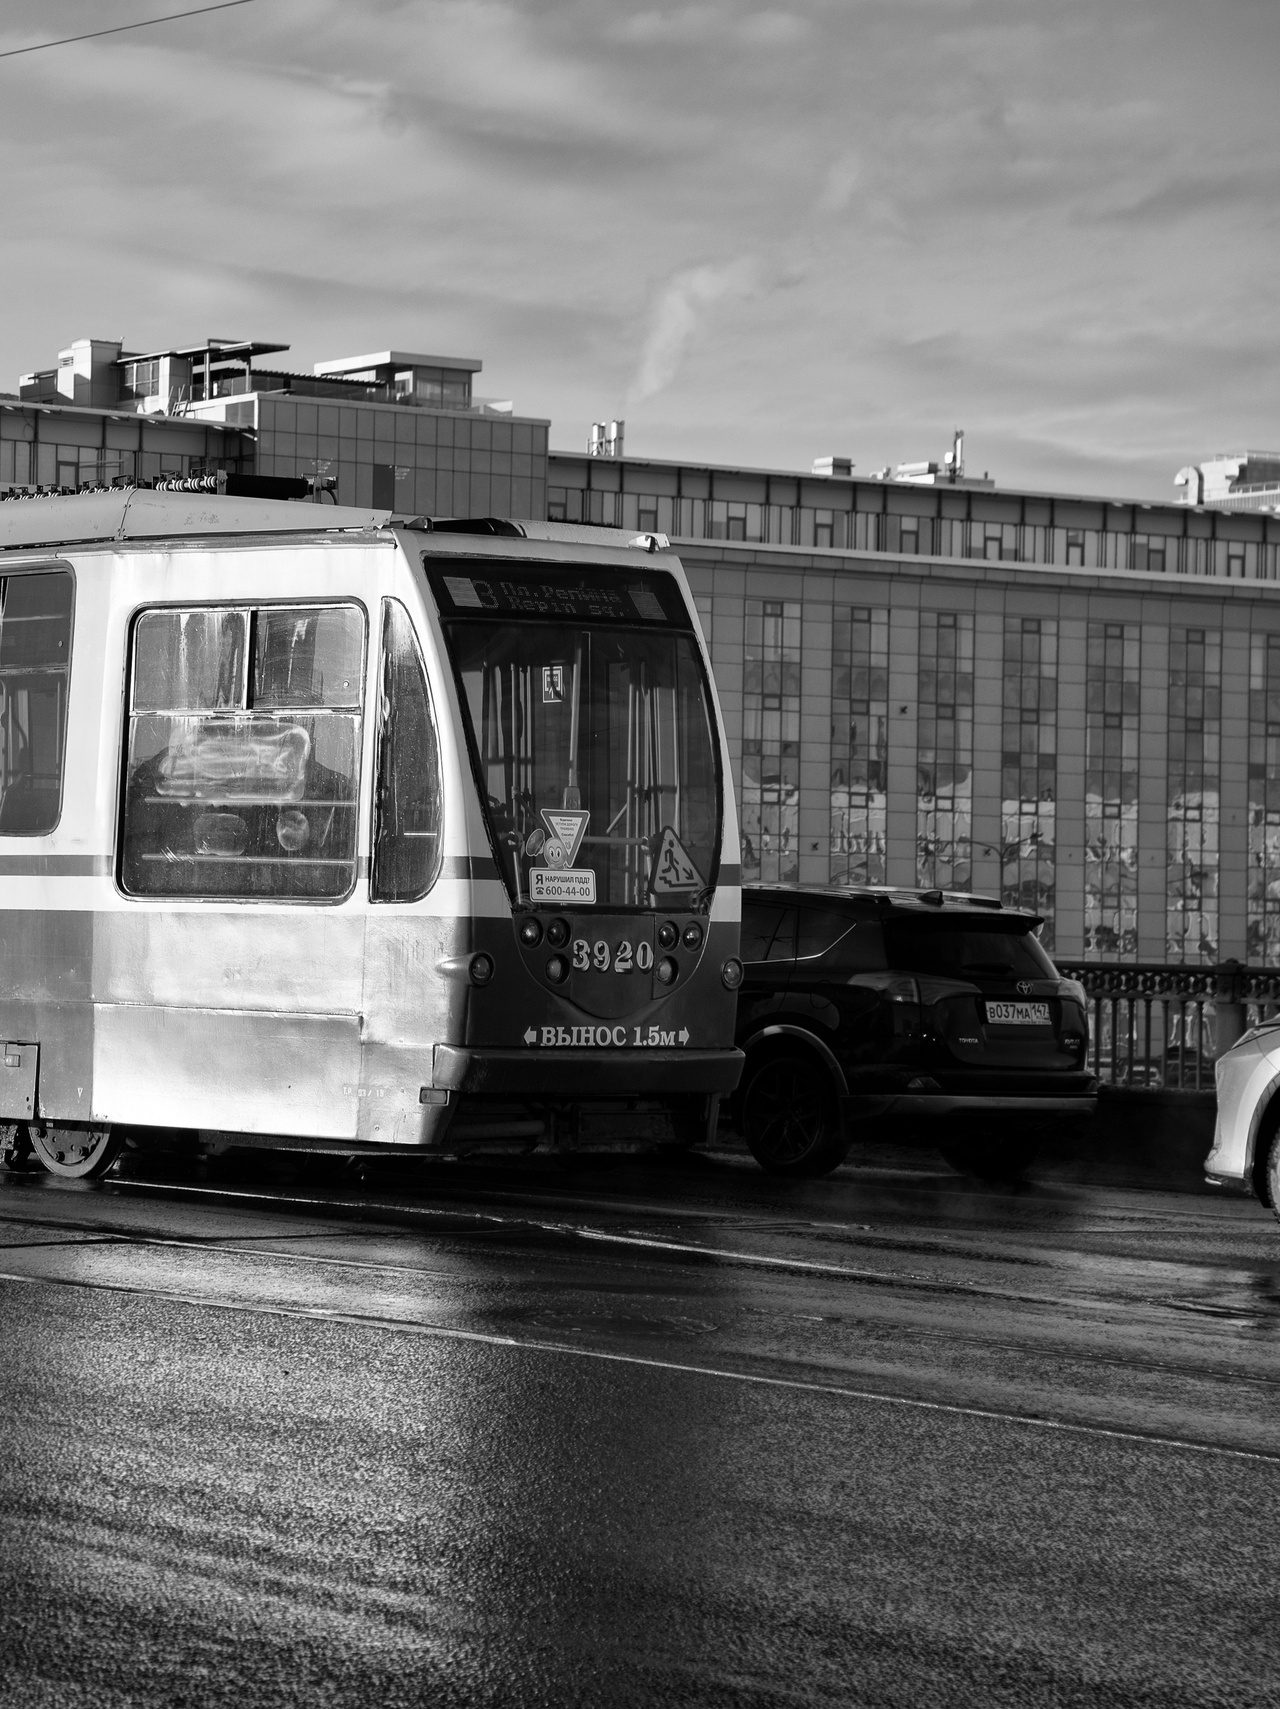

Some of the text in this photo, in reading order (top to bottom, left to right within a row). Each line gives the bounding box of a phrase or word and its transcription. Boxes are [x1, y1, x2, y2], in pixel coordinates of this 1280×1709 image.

[506, 595, 577, 614] Repin
[535, 874, 544, 885] Я
[575, 876, 590, 885] ПДД?
[545, 886, 590, 896] 600-44-00
[573, 940, 654, 973] 3920
[1031, 1004, 1046, 1017] 147
[540, 1025, 676, 1046] ВЫНОС 1.5м
